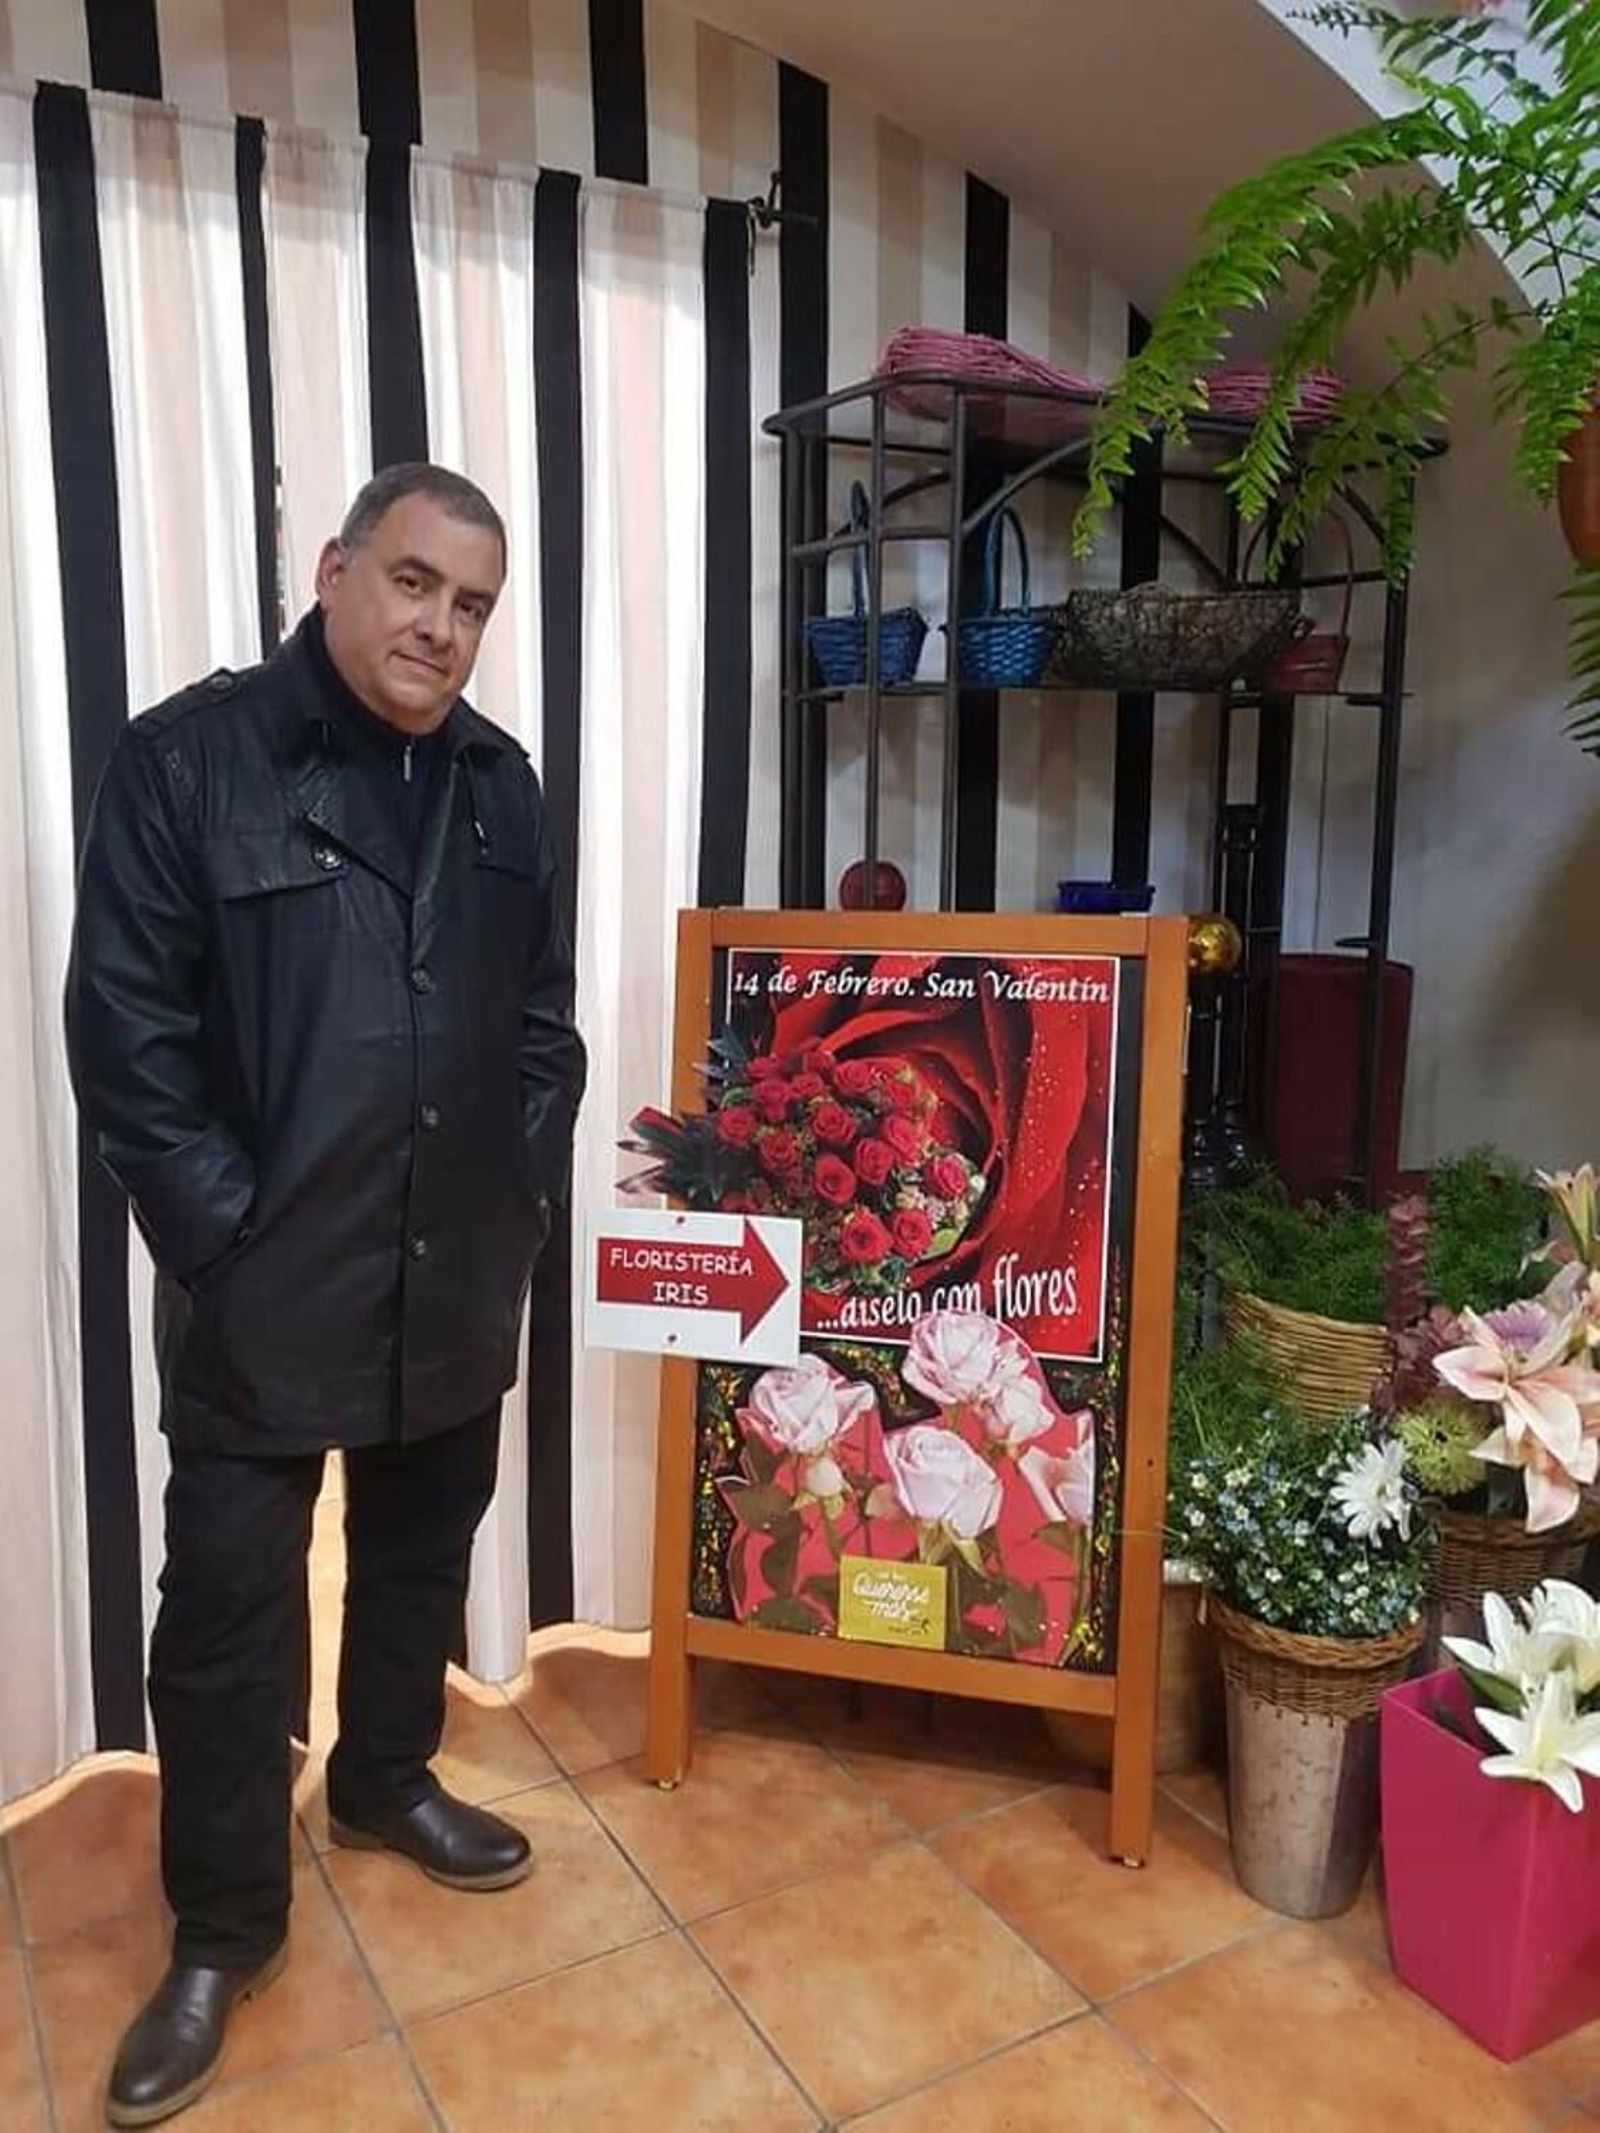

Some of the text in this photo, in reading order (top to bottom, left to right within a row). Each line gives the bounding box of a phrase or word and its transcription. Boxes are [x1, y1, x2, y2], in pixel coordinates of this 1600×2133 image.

[734, 972, 759, 997] 14
[768, 965, 797, 992] de
[802, 966, 915, 1000] Febrero.
[923, 972, 977, 999] San
[609, 1247, 754, 1276] FLORISTERÍA
[653, 1281, 709, 1305] IRIS
